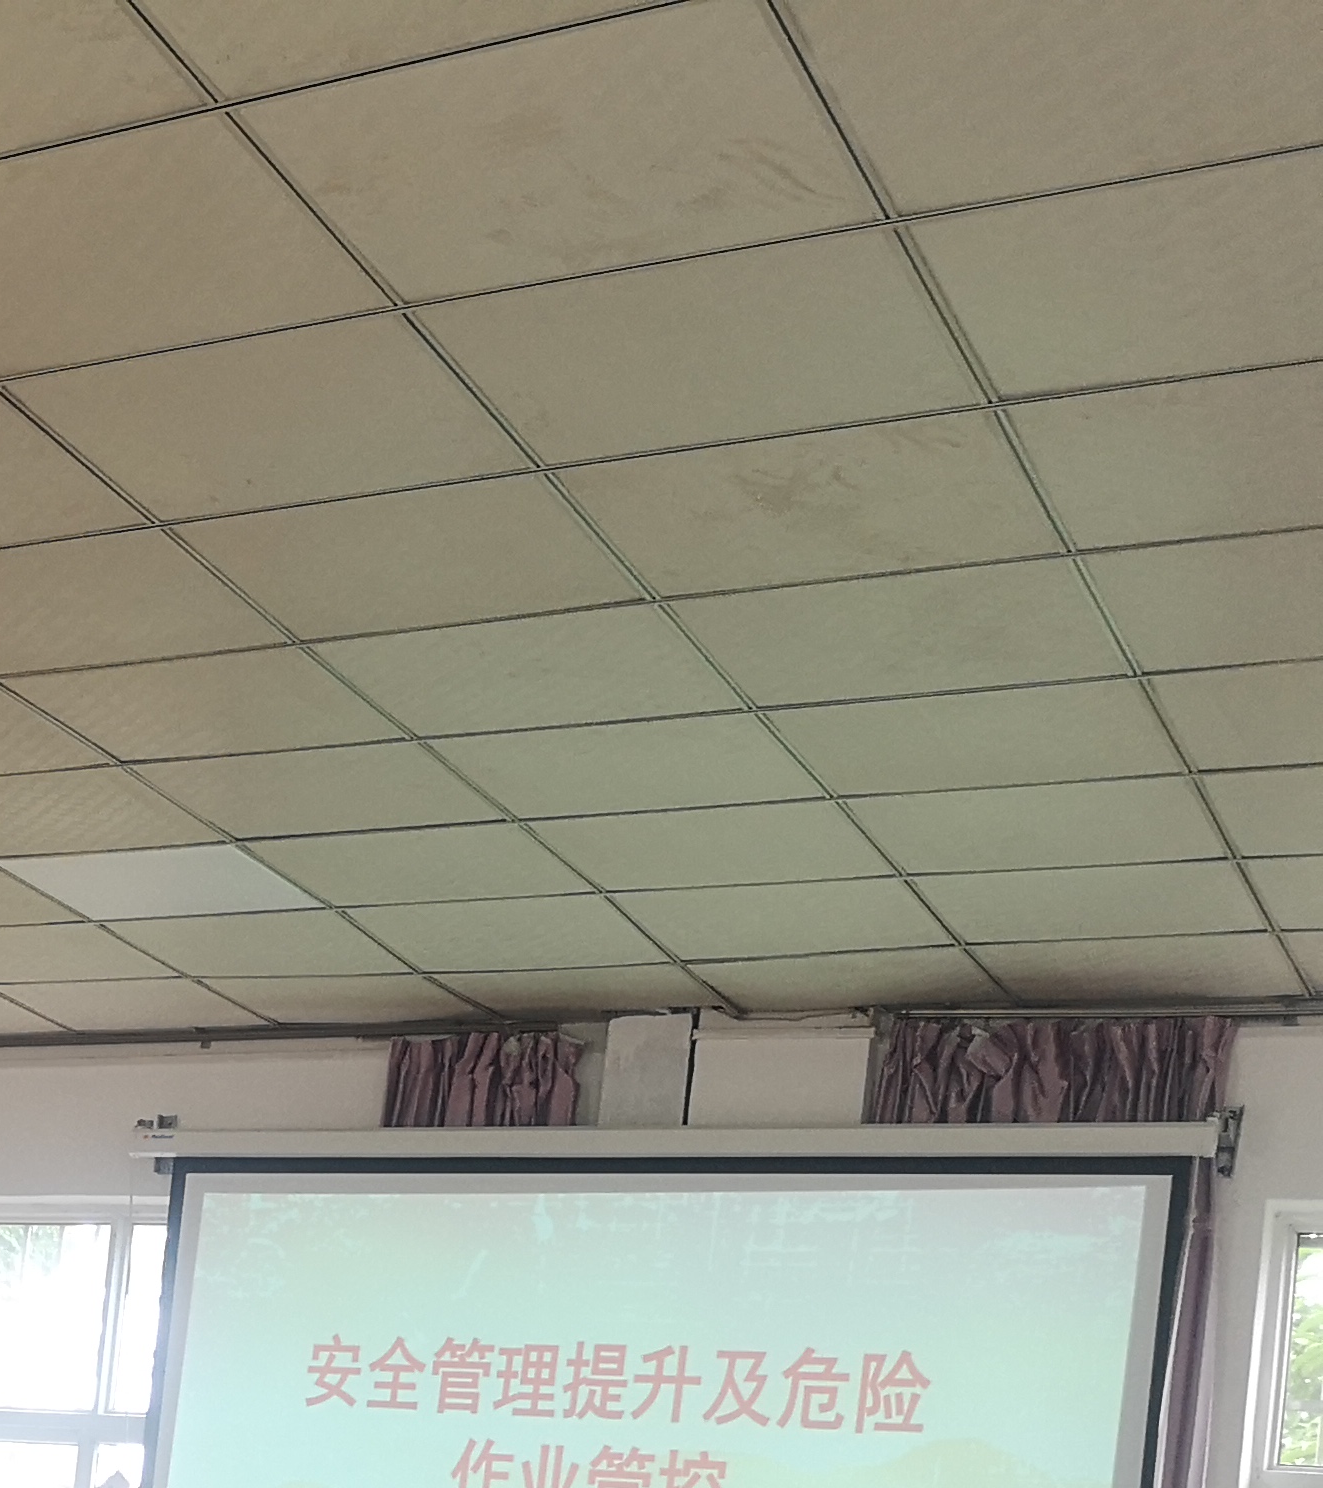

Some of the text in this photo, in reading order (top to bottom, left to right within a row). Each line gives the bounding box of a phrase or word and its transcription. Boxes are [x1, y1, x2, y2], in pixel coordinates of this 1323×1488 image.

[304, 1333, 932, 1434] 安全管理提升及危险
